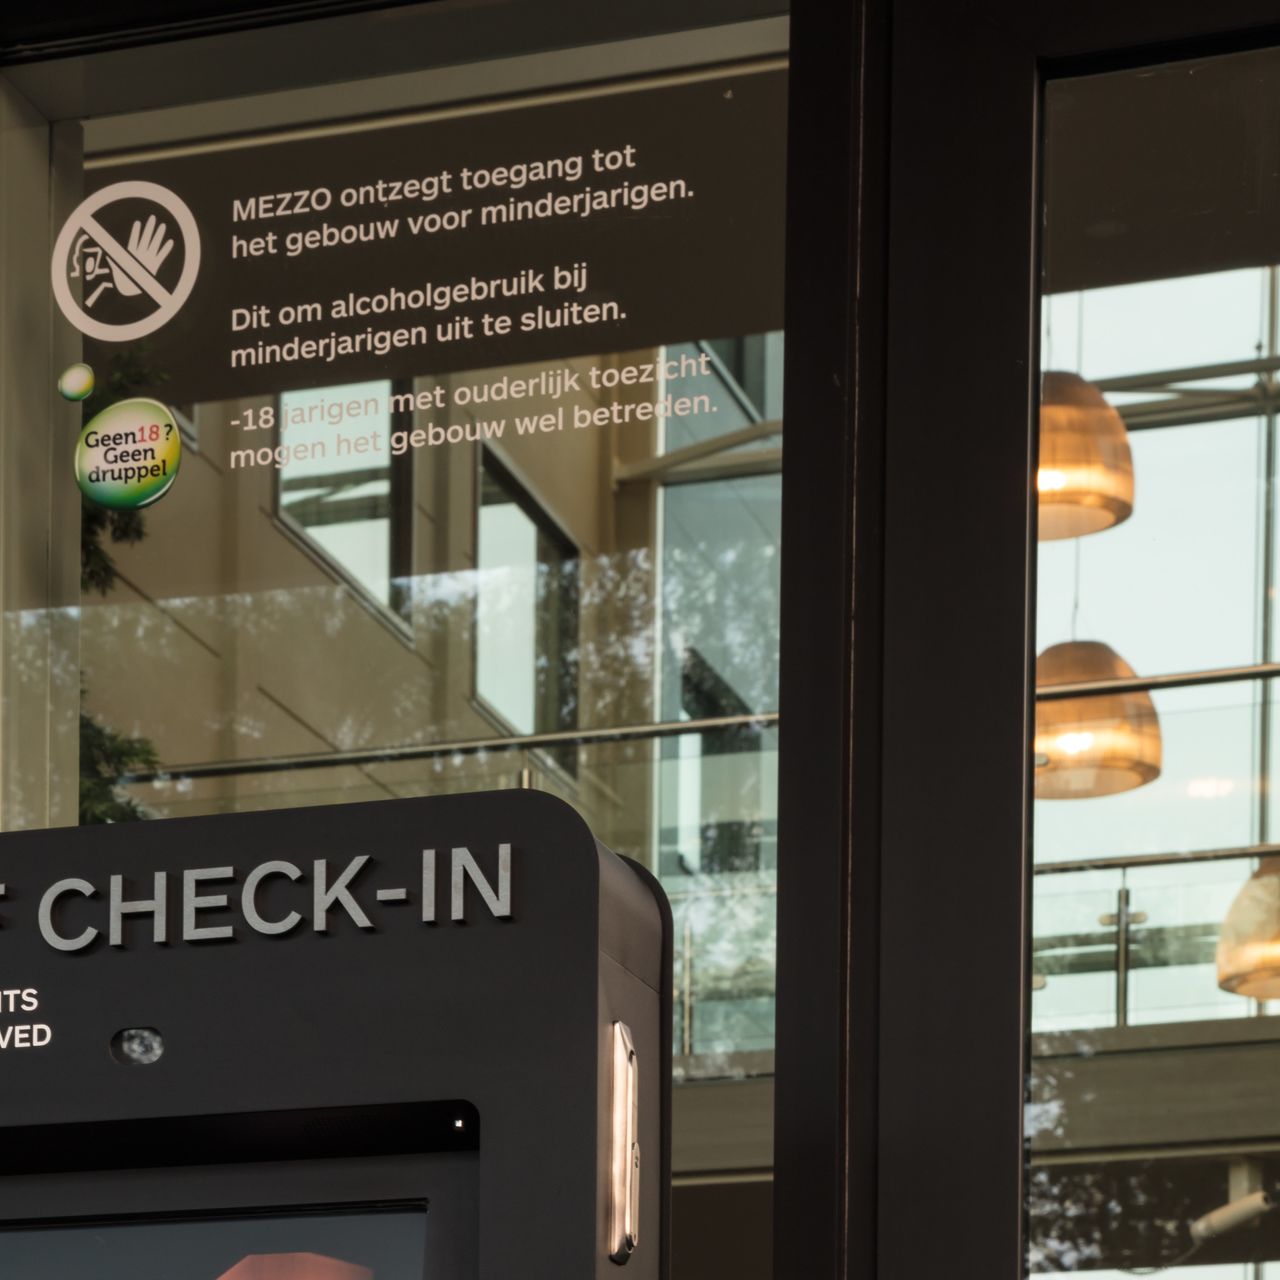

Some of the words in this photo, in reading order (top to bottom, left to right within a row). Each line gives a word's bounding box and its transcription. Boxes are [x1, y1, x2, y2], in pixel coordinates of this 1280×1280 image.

[232, 187, 332, 222] MEZZO
[340, 170, 452, 207] ontzegt
[460, 156, 583, 191] toegang
[591, 144, 636, 172] tot
[232, 231, 278, 259] het
[285, 219, 400, 257] gebouw
[407, 208, 473, 235] voor
[480, 178, 695, 226] minderjarigen.
[231, 305, 271, 332] Dit
[278, 302, 322, 325] om
[330, 269, 545, 320] alcoholgebruik
[554, 262, 587, 293] bij
[231, 320, 427, 368] minderjarigen
[436, 316, 474, 342] uit
[481, 313, 512, 336] te
[520, 301, 627, 332] sluiten.
[230, 405, 274, 434] -18
[281, 395, 378, 433] jarigen
[388, 384, 445, 415] met
[453, 367, 580, 406] ouderlijk
[589, 351, 711, 389] toezicht
[230, 436, 327, 471] mogen
[335, 427, 382, 457] het
[390, 413, 505, 454] gebouw
[513, 405, 563, 435] wel
[571, 388, 719, 429] betreden.
[88, 460, 167, 483] druppel
[104, 448, 155, 463] Geen
[38, 842, 514, 953] CHECK-IN
